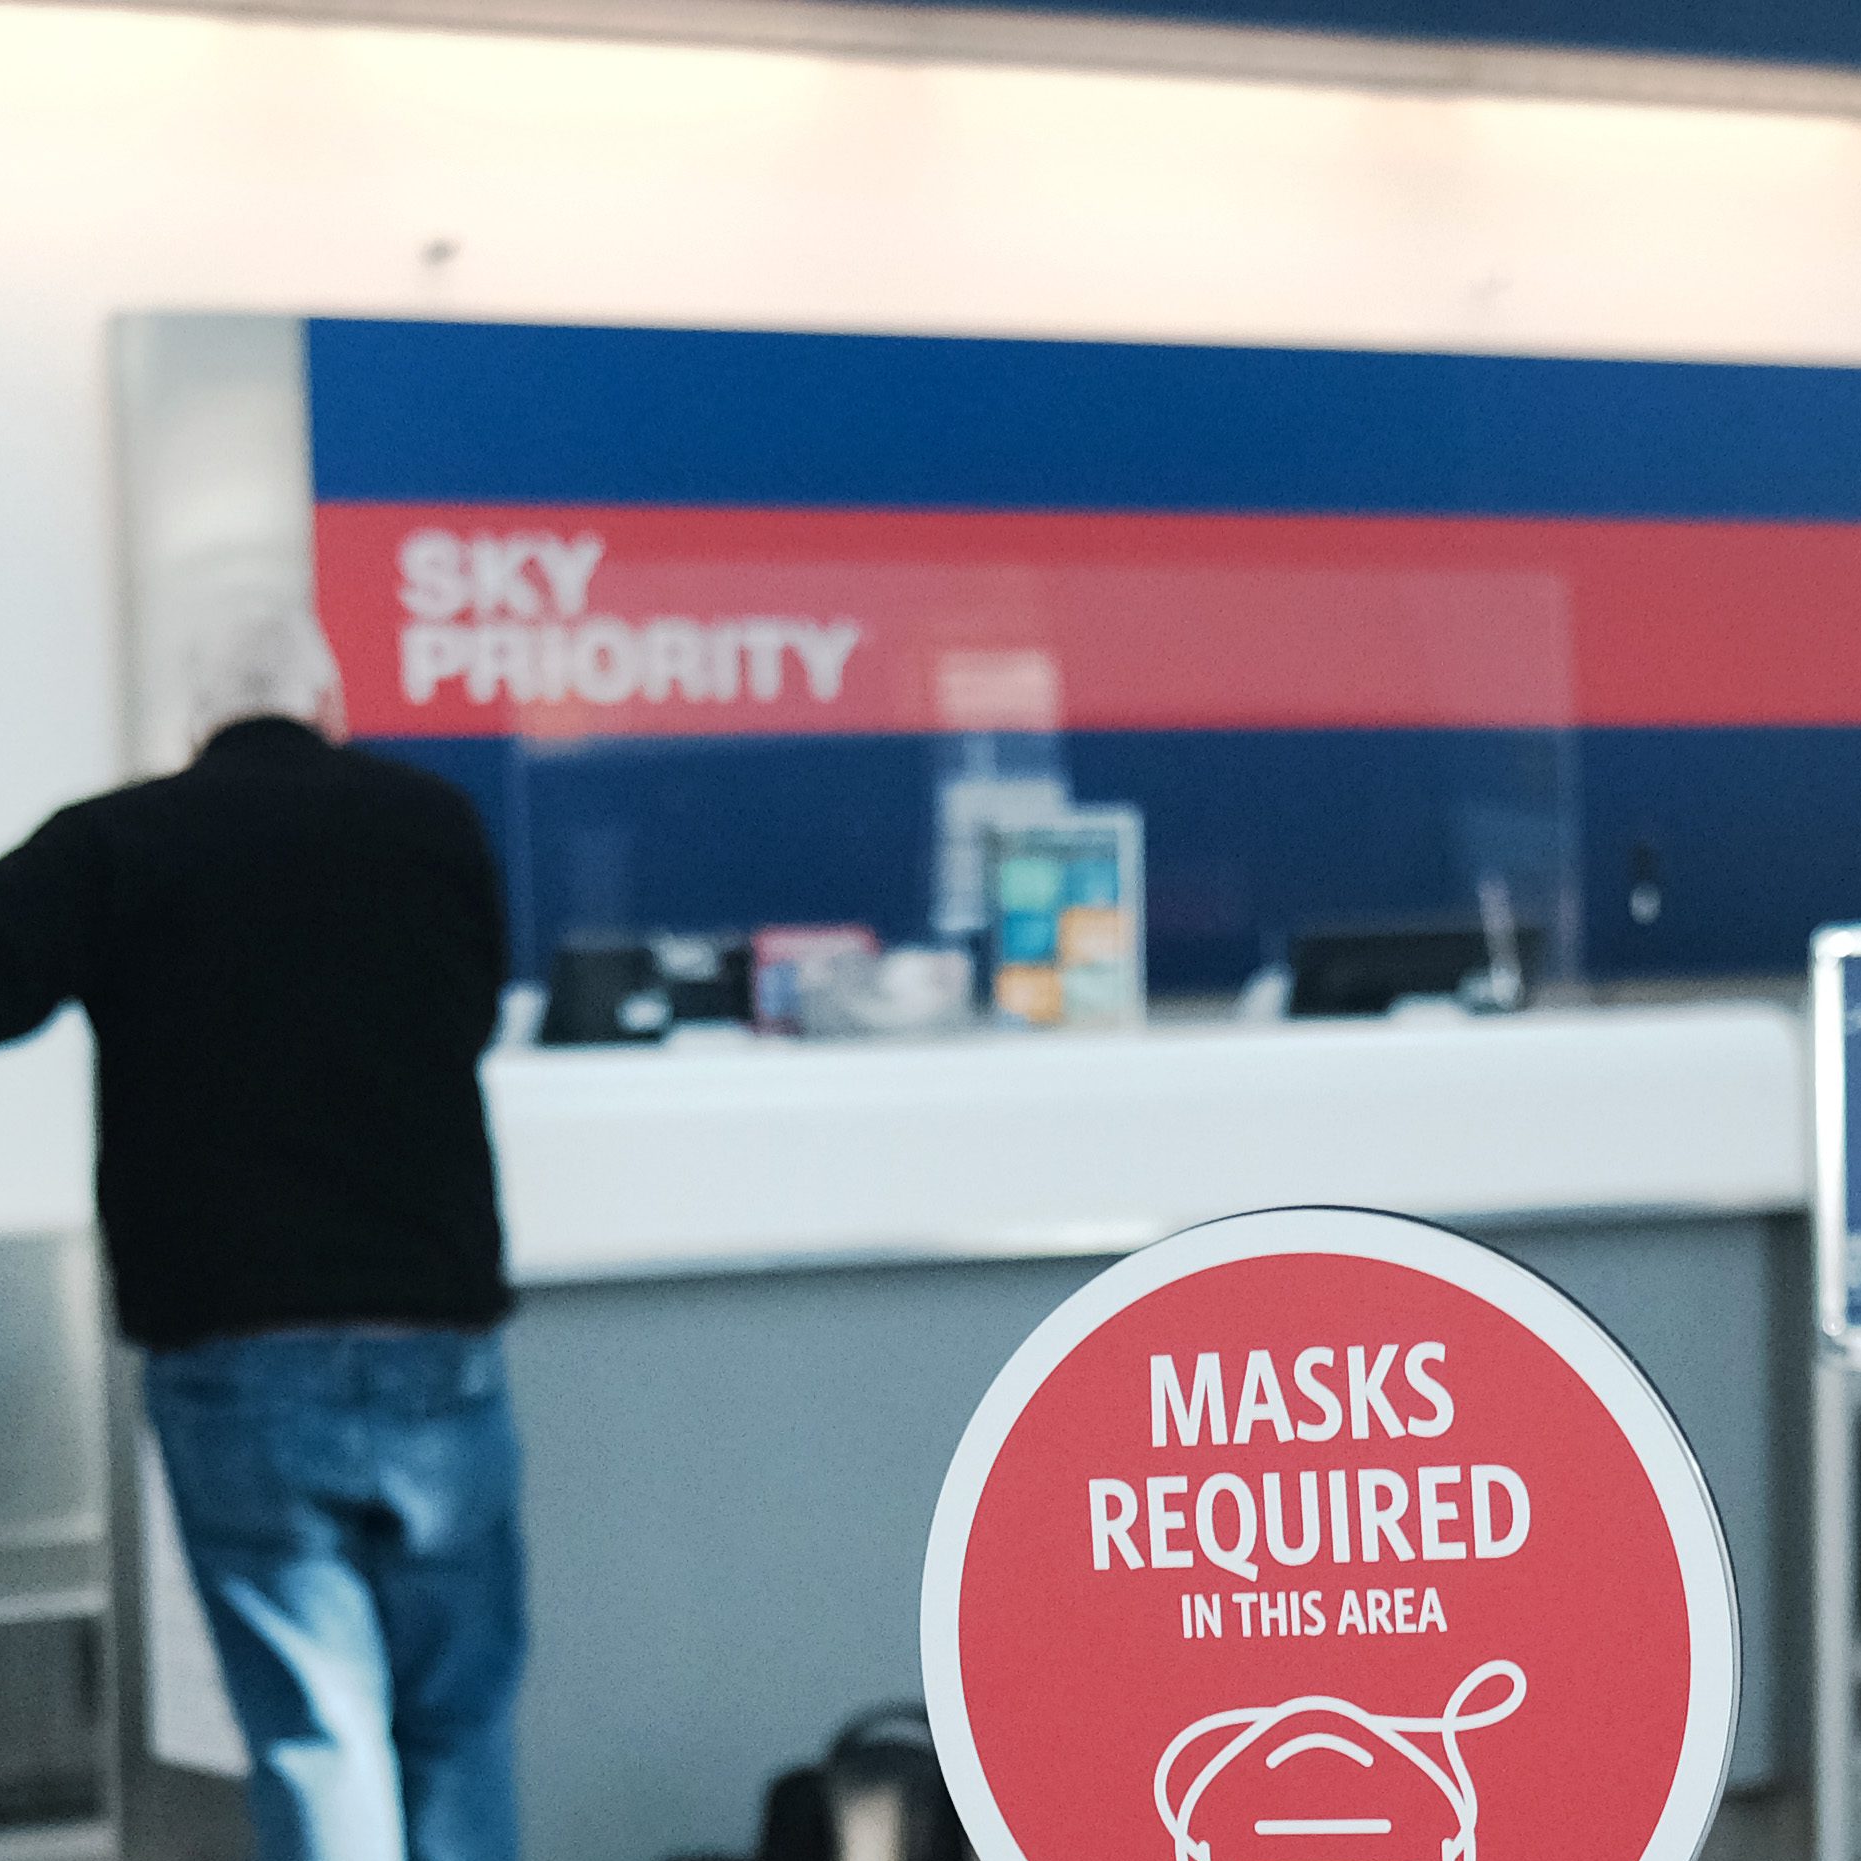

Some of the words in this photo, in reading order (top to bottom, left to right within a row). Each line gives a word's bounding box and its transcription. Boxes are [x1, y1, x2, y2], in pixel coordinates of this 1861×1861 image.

[397, 529, 605, 621] SKY
[399, 616, 862, 706] PRIORITY
[1148, 1341, 1457, 1449] MASKS
[1087, 1463, 1532, 1582] REQUIRED
[1180, 1593, 1223, 1639] IN
[1231, 1590, 1327, 1638] THIS
[1336, 1586, 1449, 1636] AREA
